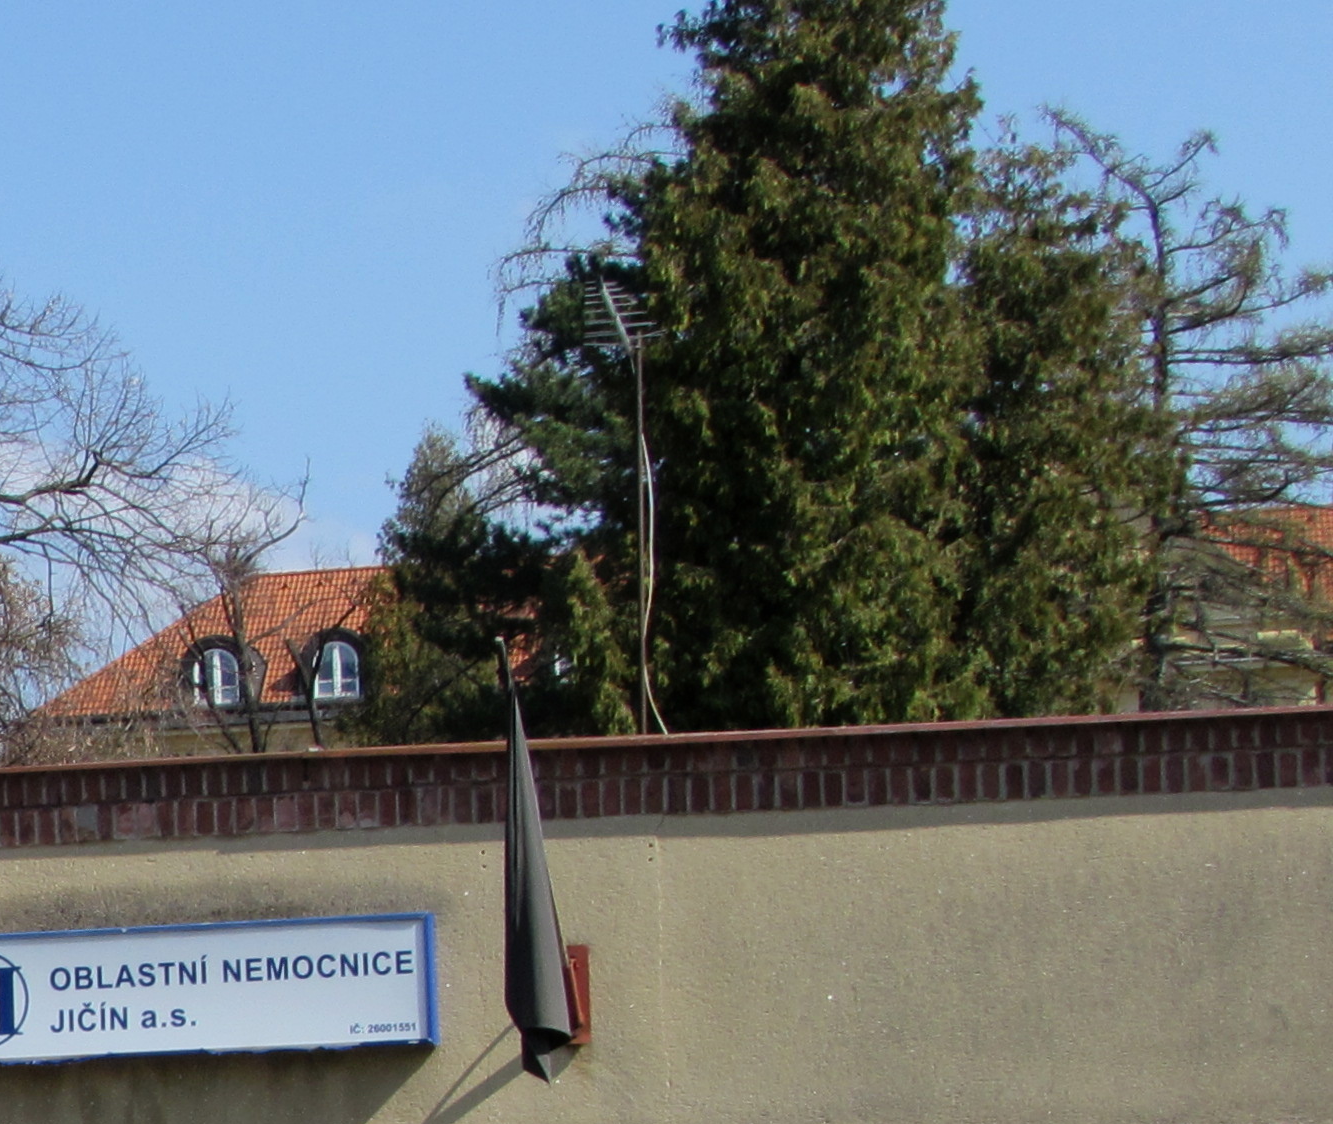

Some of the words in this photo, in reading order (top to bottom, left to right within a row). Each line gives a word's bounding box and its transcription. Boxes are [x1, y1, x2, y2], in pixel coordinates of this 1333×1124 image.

[49, 954, 208, 991] OBLASTNÍ
[222, 950, 414, 983] NEMOCNICE
[49, 1001, 129, 1033] JIČÍN
[140, 1008, 198, 1029] a.s.
[367, 1022, 416, 1034] 26001551
